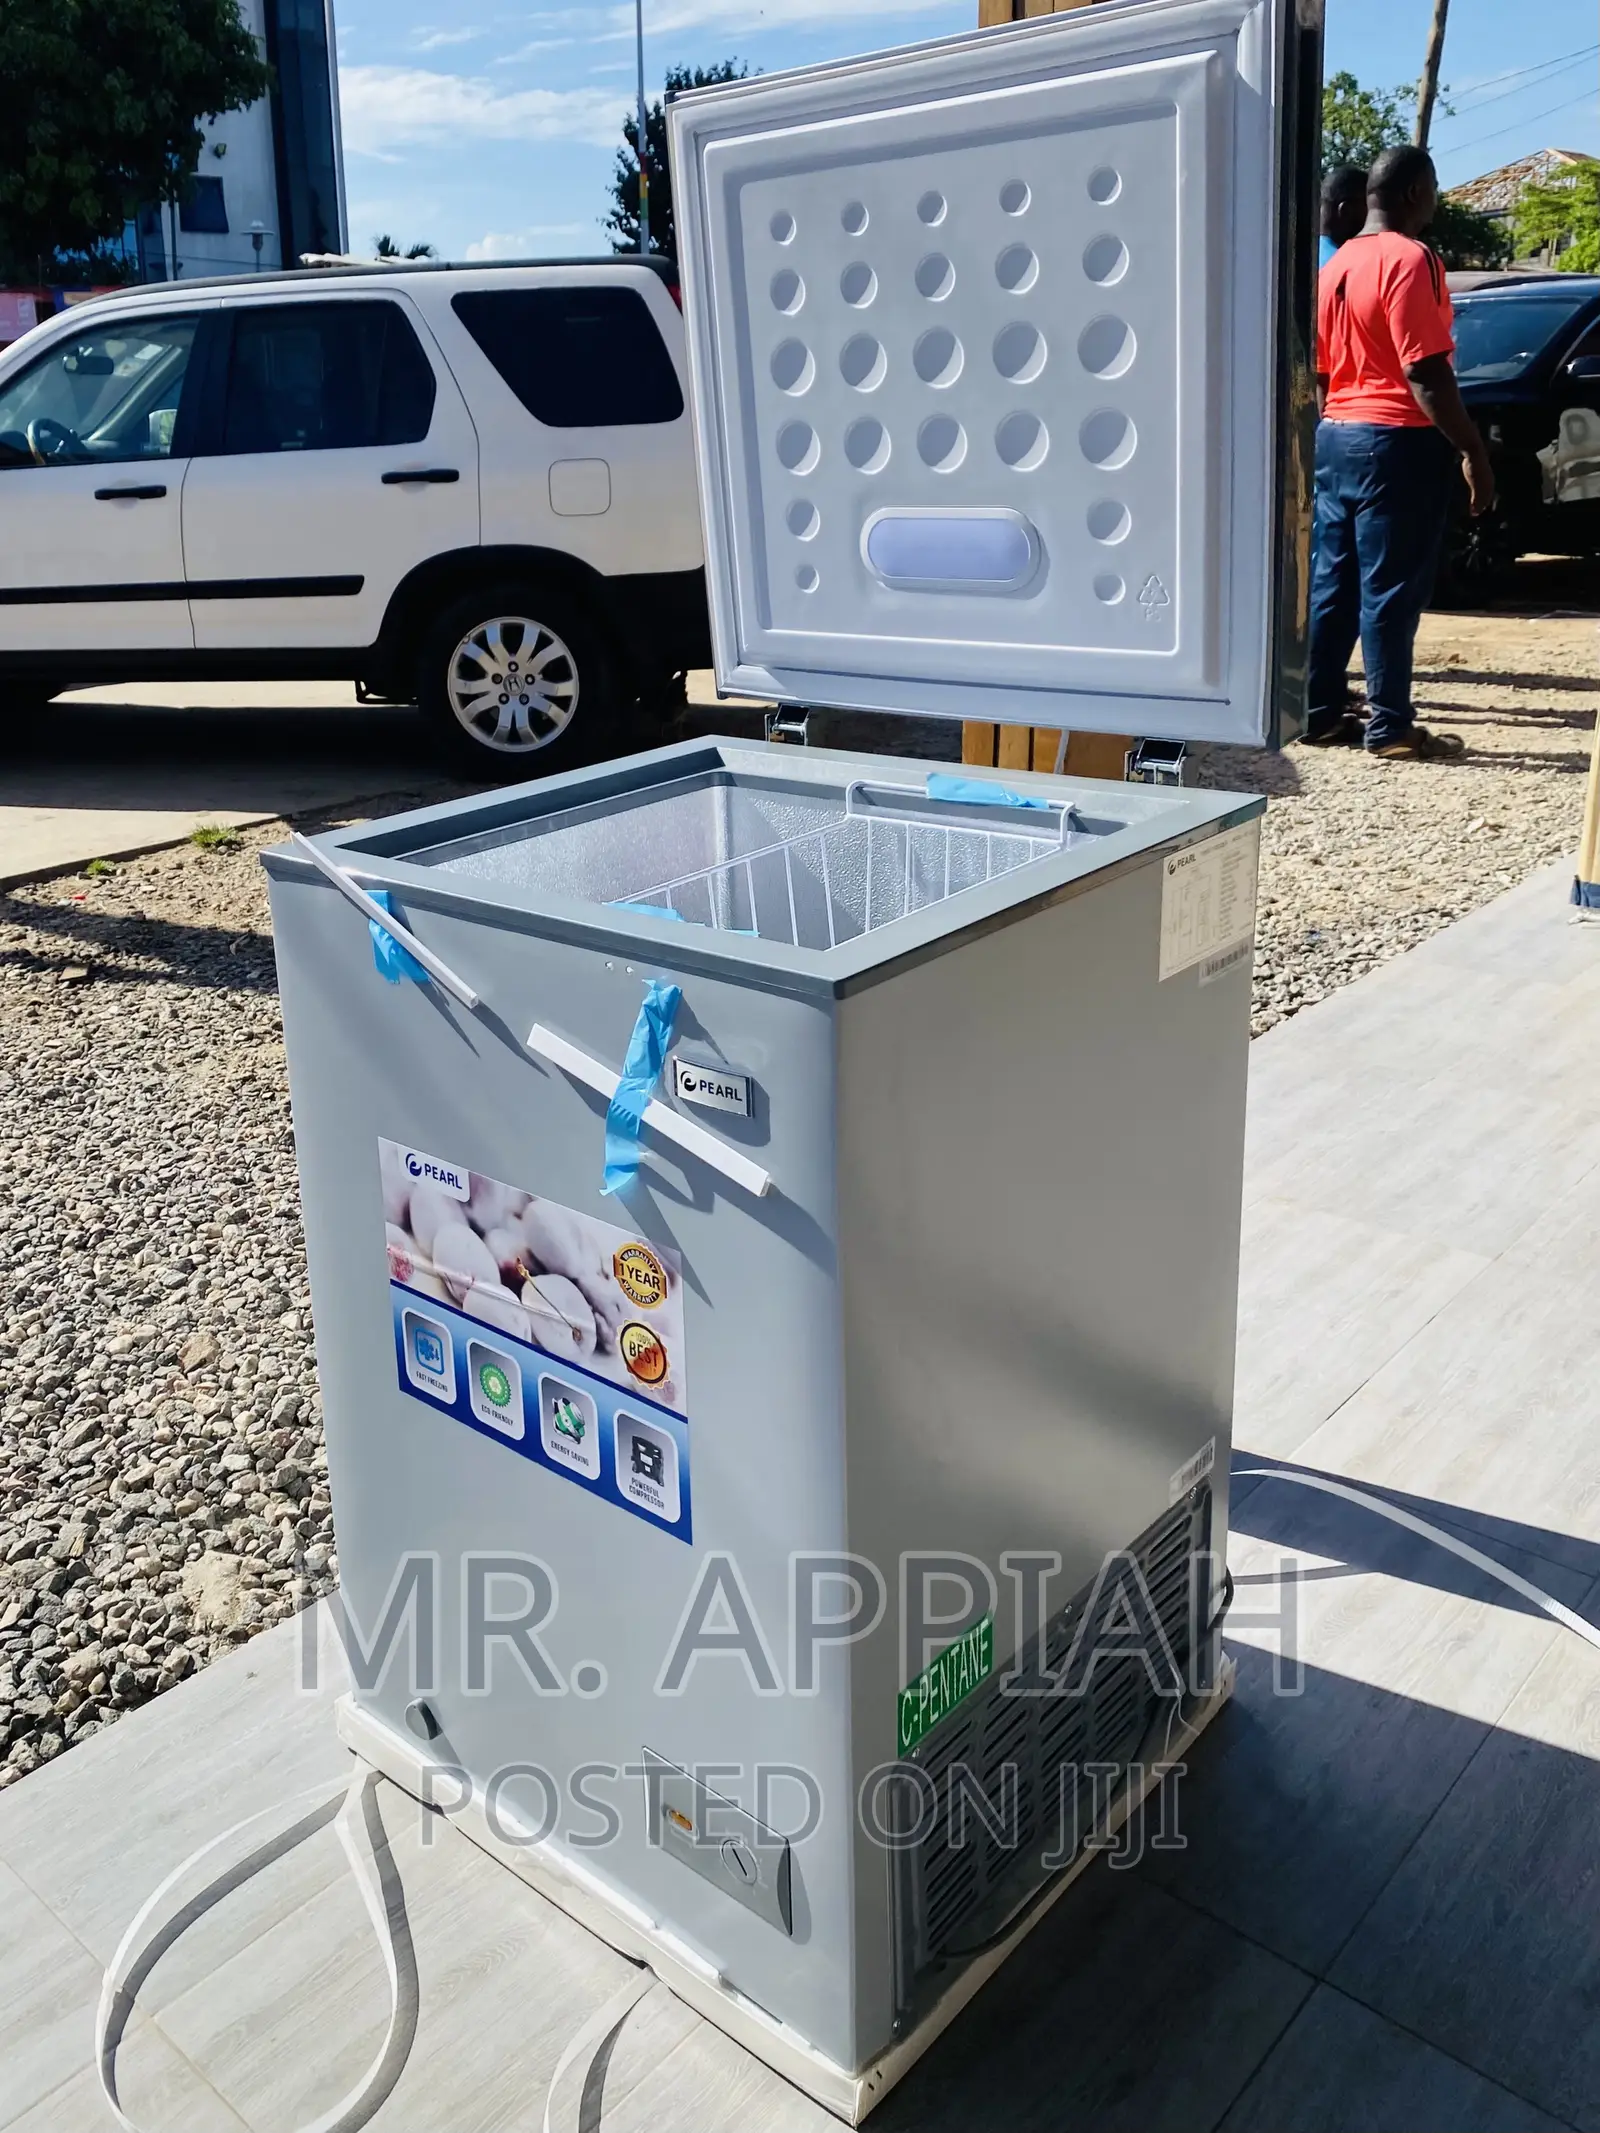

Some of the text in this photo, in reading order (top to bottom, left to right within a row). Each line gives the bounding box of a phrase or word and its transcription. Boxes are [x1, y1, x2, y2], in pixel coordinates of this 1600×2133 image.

[1177, 853, 1197, 869] PEARL
[699, 1079, 743, 1102] PEARL
[424, 1163, 463, 1190] PEARL
[622, 1249, 656, 1272] WARRANTY
[619, 1263, 661, 1291] 1 YEAR
[623, 1280, 657, 1304] WARRANTY
[629, 1341, 659, 1367] BEST
[416, 1370, 427, 1382] FAST
[481, 1405, 514, 1426] ECO FRIENDLY
[551, 1440, 589, 1467] ENERGY SAVING
[628, 1485, 665, 1510] COMPRESSOR
[631, 1477, 660, 1498] POWERFUL
[901, 1618, 989, 1747] C-PENTANE
